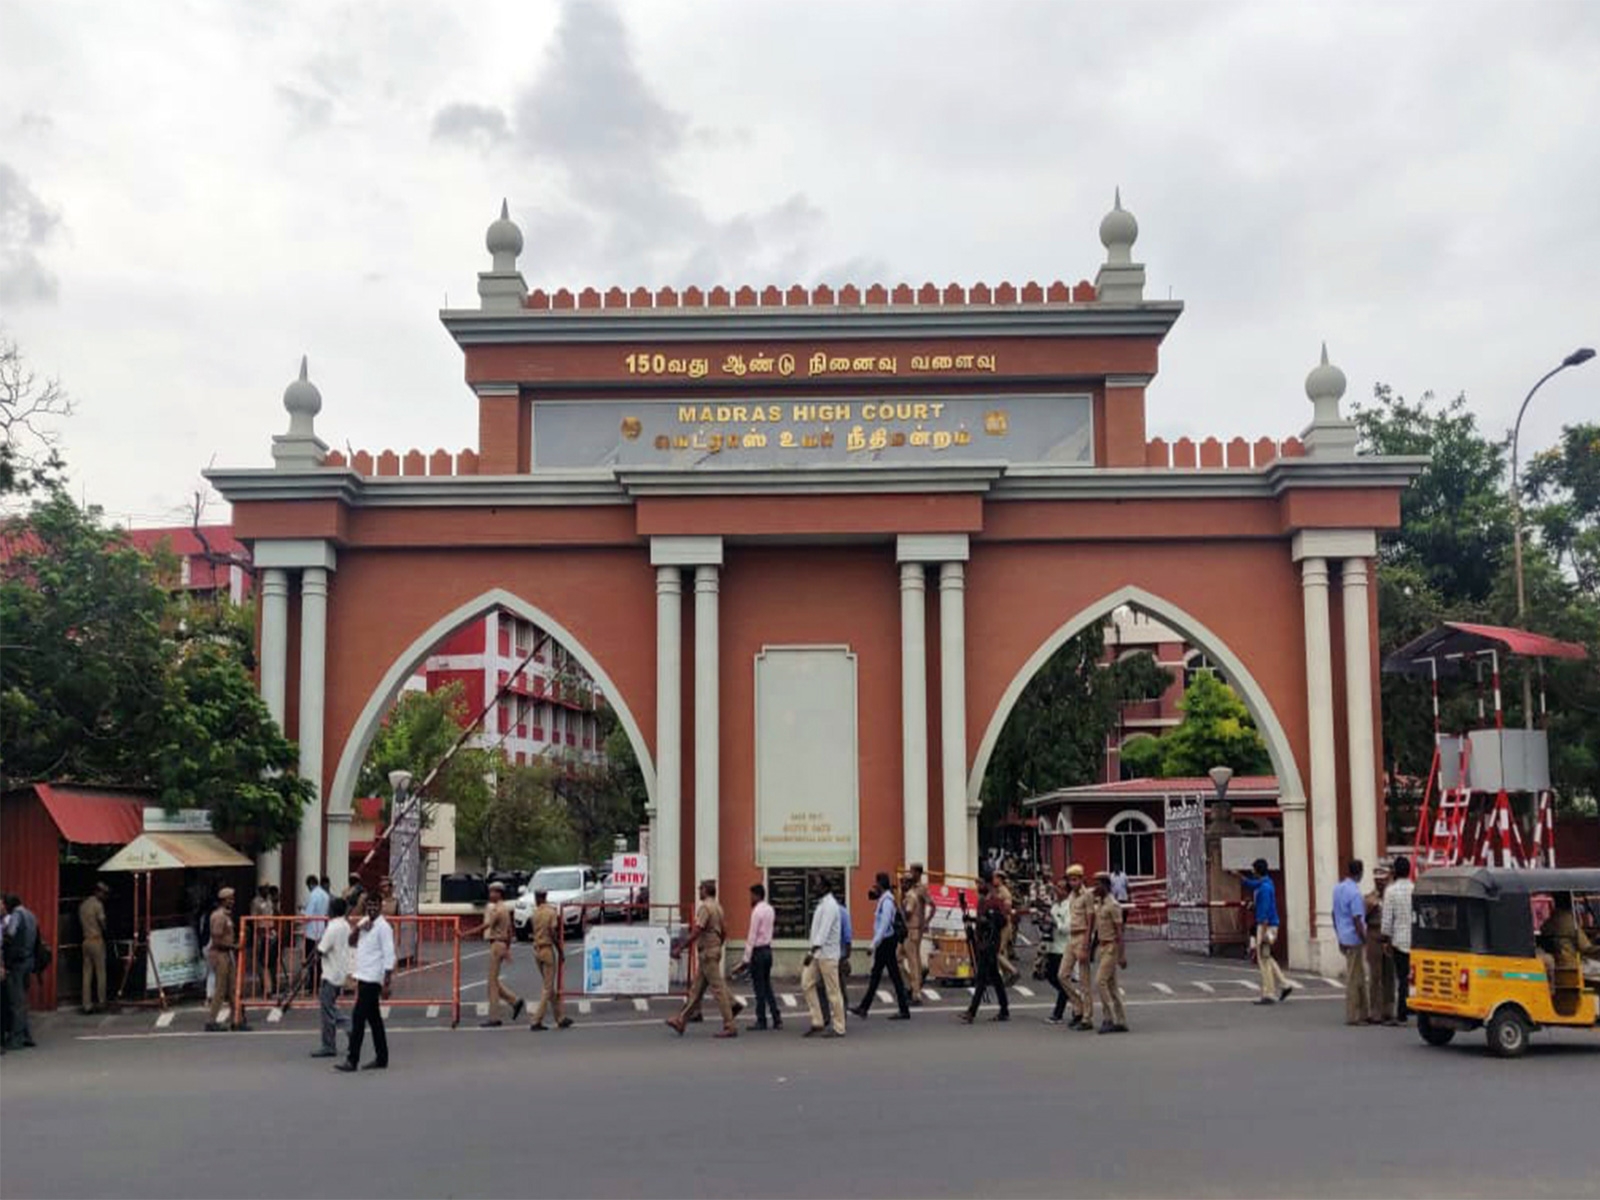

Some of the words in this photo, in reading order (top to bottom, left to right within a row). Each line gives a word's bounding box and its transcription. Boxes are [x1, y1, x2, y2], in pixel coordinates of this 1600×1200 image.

[626, 354, 709, 378] 150வது
[722, 352, 795, 376] ஆண்டு
[808, 352, 897, 376] நினைவு
[911, 354, 996, 373] வளைவு
[678, 406, 782, 423] MADRAS
[793, 405, 851, 422] HIGH
[861, 403, 945, 421] COURT
[623, 857, 637, 867] NO
[614, 872, 645, 884] ENTRY
